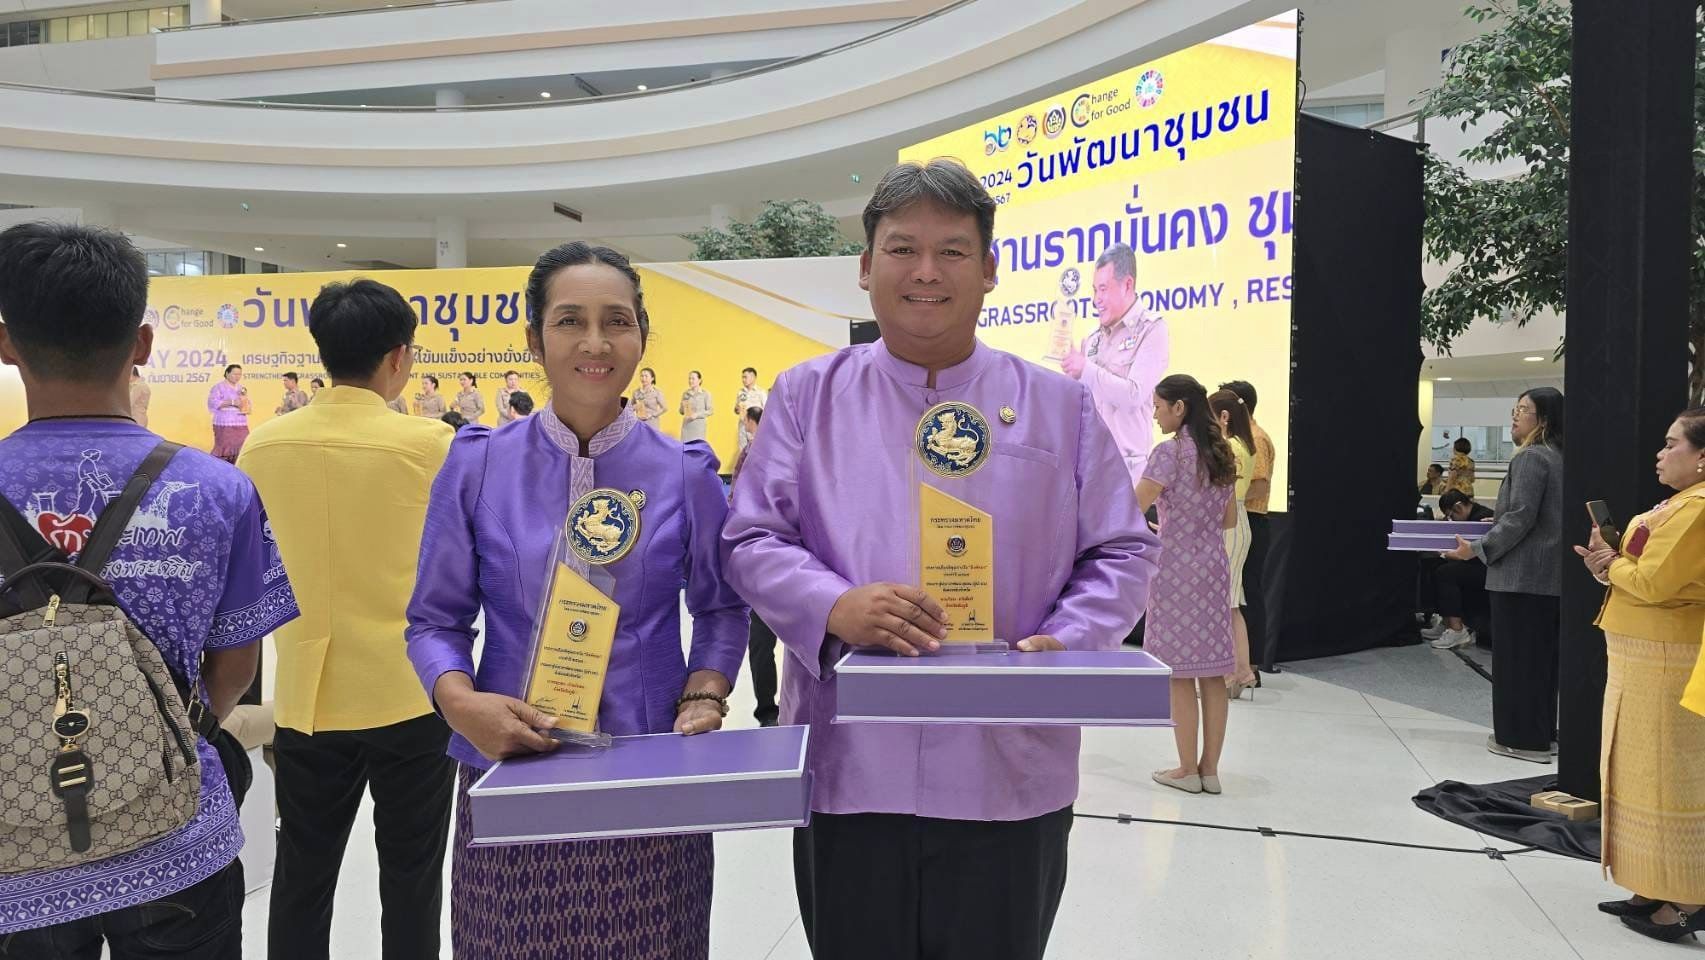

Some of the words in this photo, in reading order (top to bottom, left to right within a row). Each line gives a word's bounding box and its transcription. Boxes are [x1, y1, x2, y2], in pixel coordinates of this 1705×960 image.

[1091, 110, 1104, 120] for
[1106, 98, 1131, 116] Good
[1017, 89, 1270, 188] วันพัฒนาชุมชน
[994, 192, 1011, 205] 567
[1140, 282, 1225, 312] ONOMY
[176, 349, 228, 368] 2024
[186, 372, 211, 383] 2567
